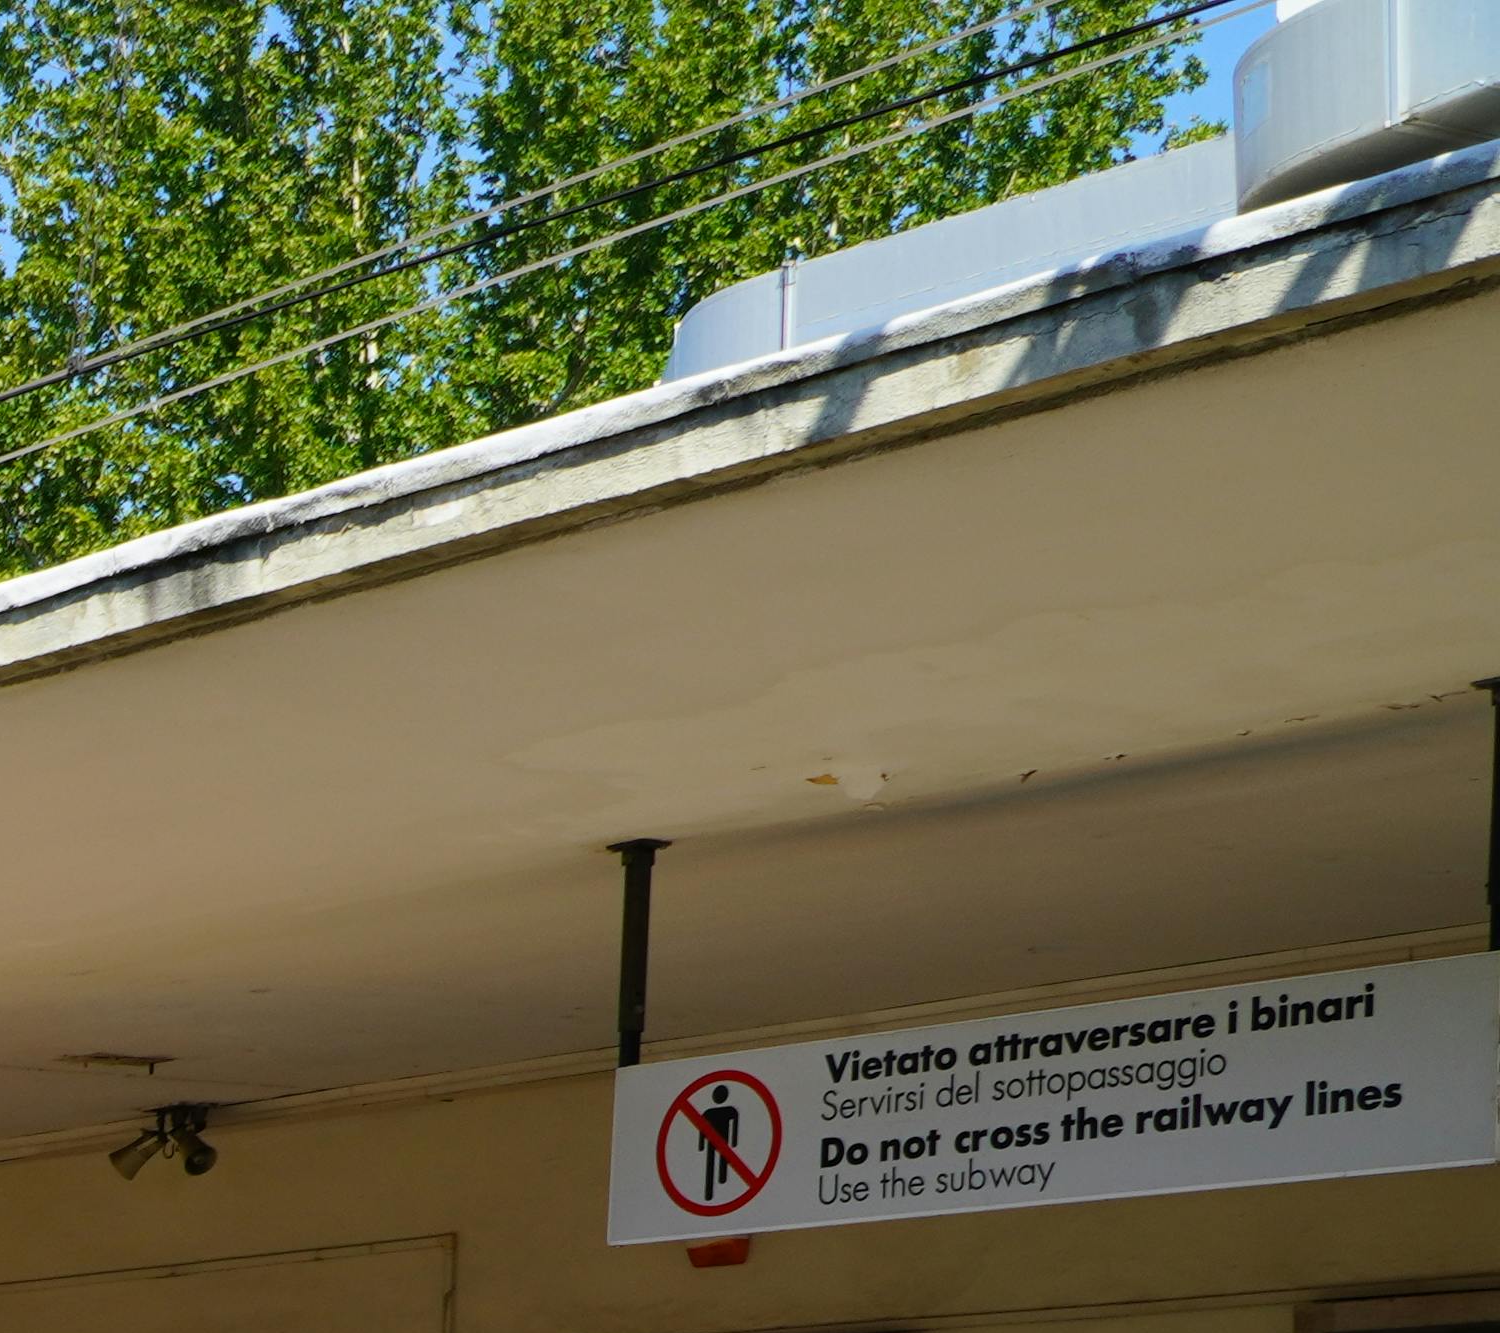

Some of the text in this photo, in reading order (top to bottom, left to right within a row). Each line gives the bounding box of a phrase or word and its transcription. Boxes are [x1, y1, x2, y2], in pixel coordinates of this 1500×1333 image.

[825, 982, 1375, 1084] Vietato attraversare i binari
[820, 1080, 1403, 1169] Do not cross the railway lines
[821, 1049, 1227, 1121] Servirsi del sottopassaggio
[818, 1158, 1055, 1205] Use the subway
